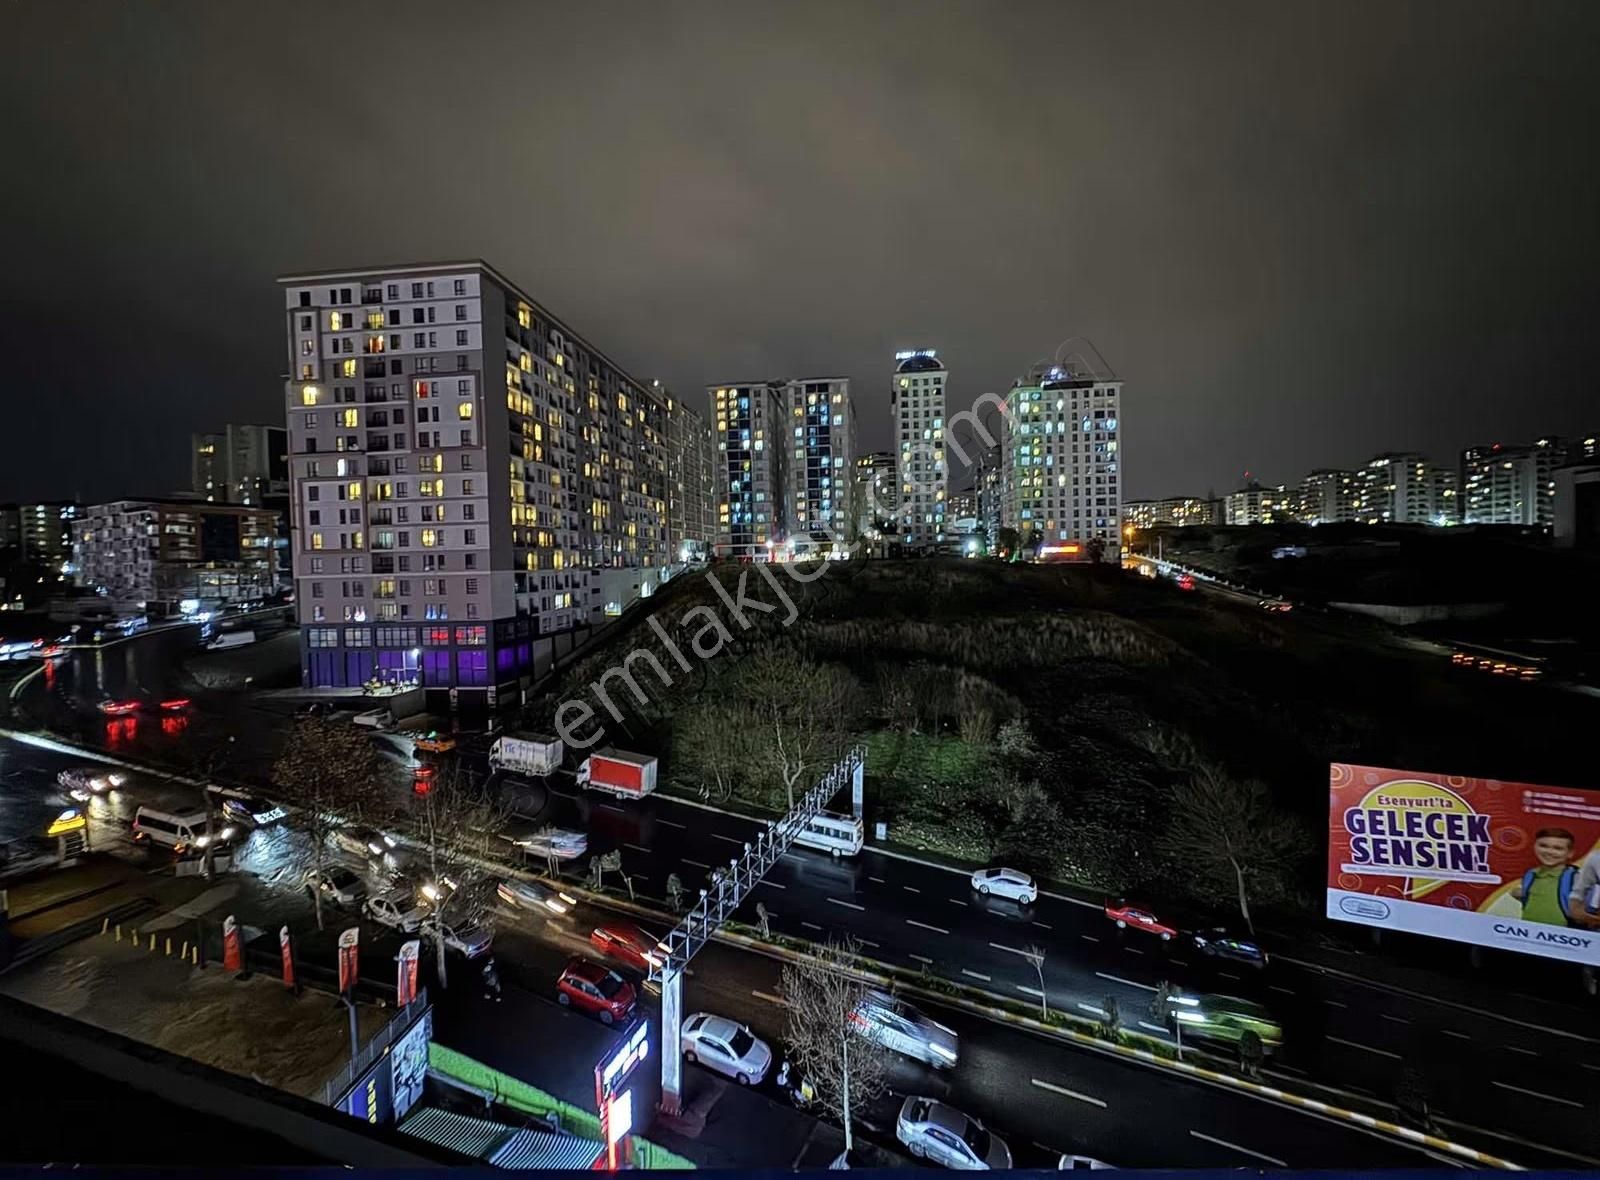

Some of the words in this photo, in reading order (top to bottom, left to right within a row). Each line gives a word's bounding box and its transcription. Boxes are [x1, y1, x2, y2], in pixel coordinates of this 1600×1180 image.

[1377, 794, 1454, 808] Esenyurt'ta
[1345, 808, 1491, 843] GELECEK
[1493, 923, 1529, 938] CAN
[1535, 932, 1592, 949] AKSOY
